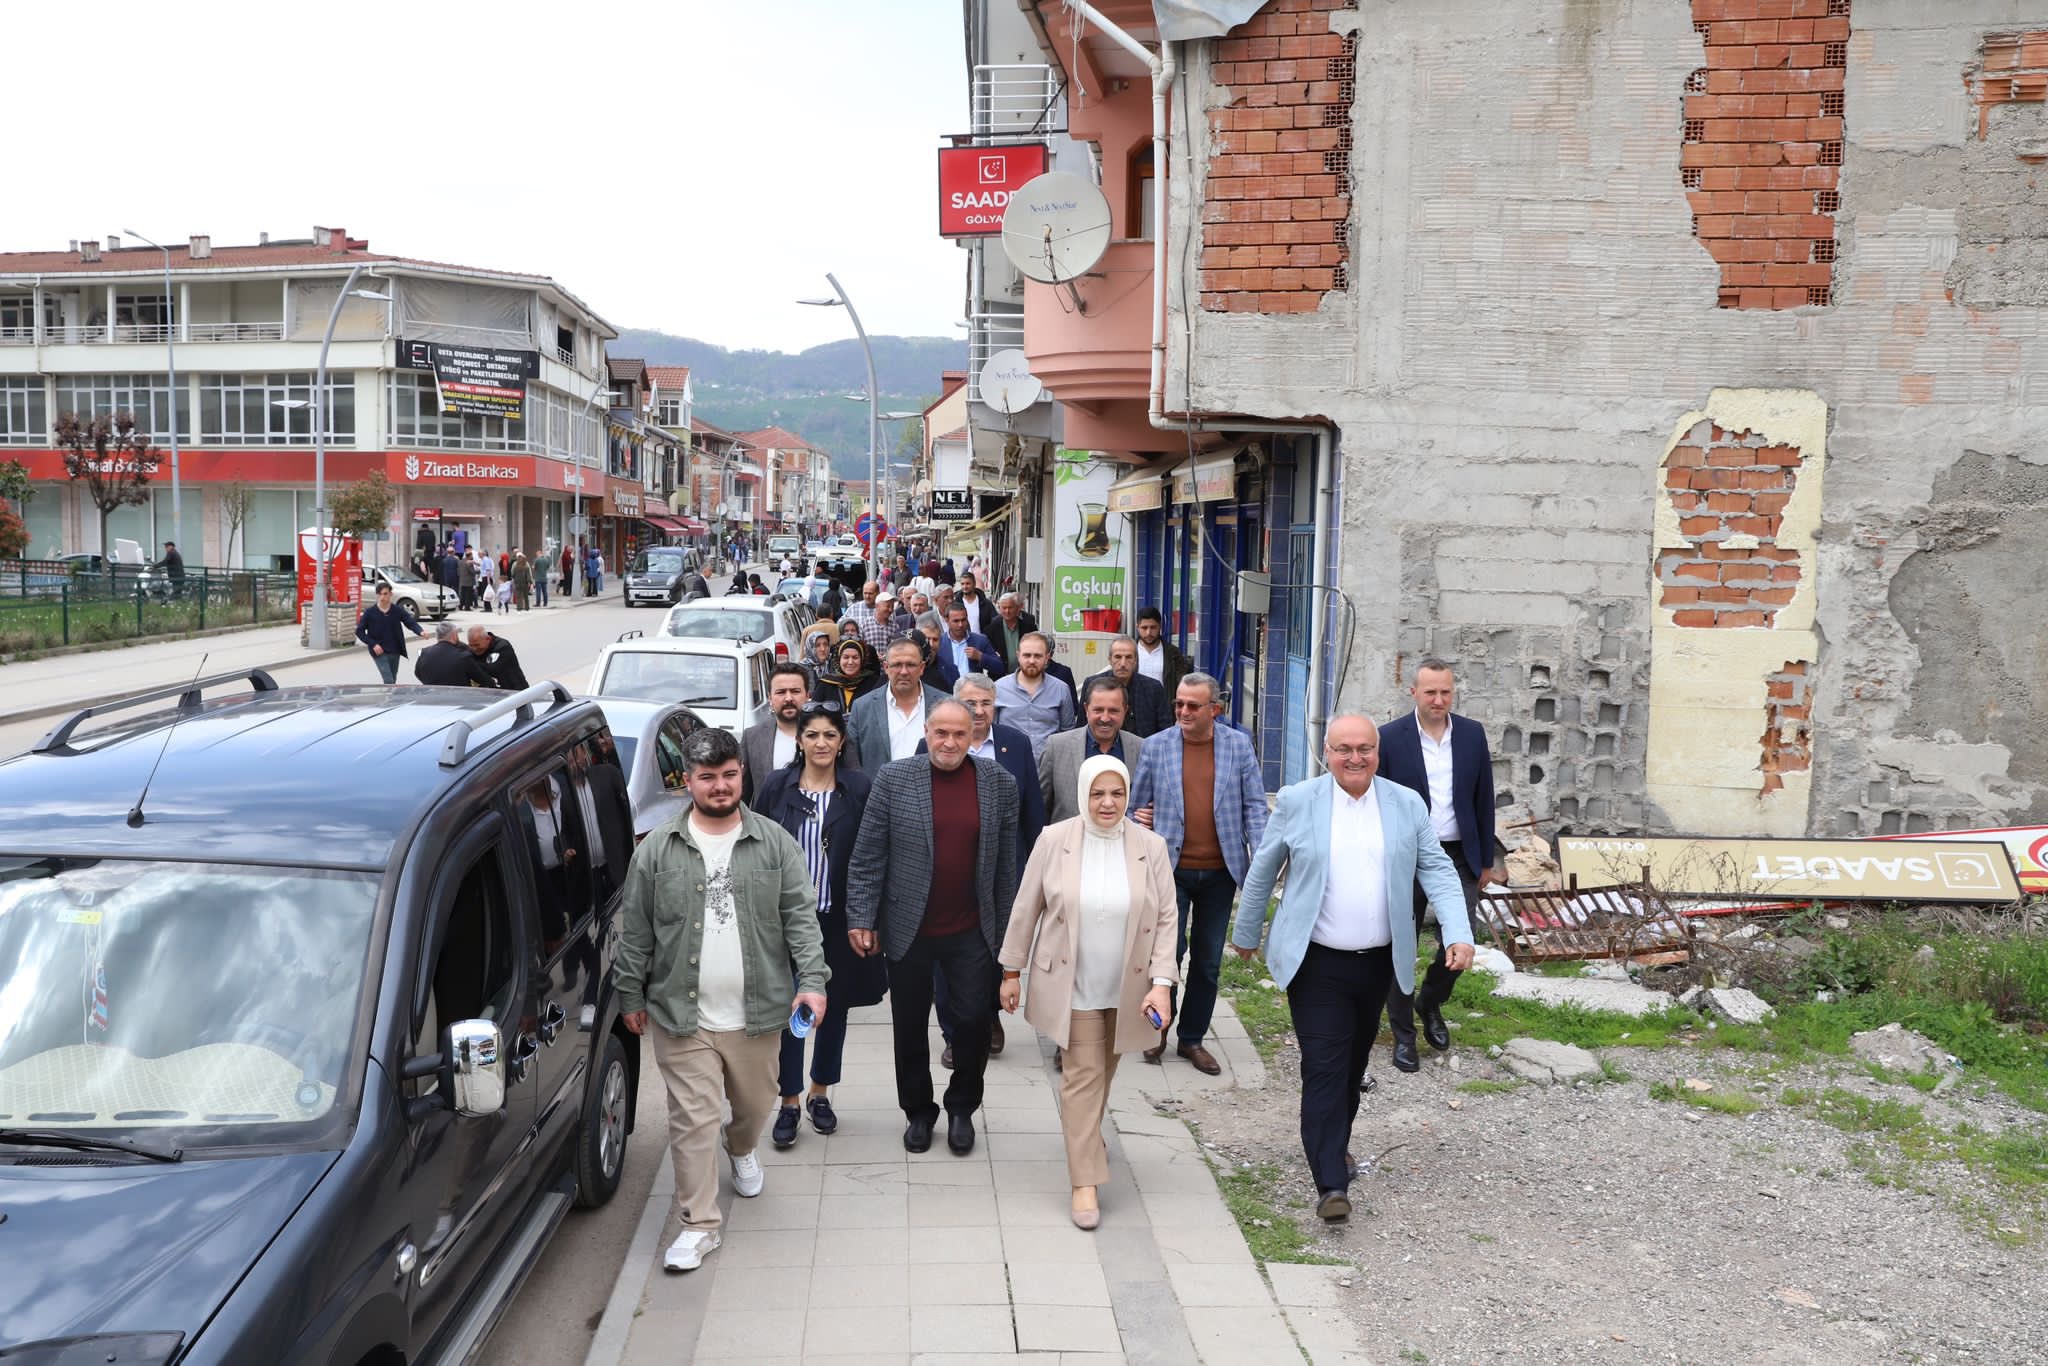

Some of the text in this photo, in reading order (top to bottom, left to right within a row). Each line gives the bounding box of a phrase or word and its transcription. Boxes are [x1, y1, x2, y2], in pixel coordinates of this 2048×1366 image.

[965, 214, 1004, 225] GÖLYA
[438, 348, 453, 357] USTA
[423, 460, 518, 479] Ziraat Bankası
[935, 491, 968, 503] NET
[1061, 575, 1122, 600] Coşkun
[1061, 603, 1083, 627] Ça
[1751, 855, 1936, 882] SAADET
